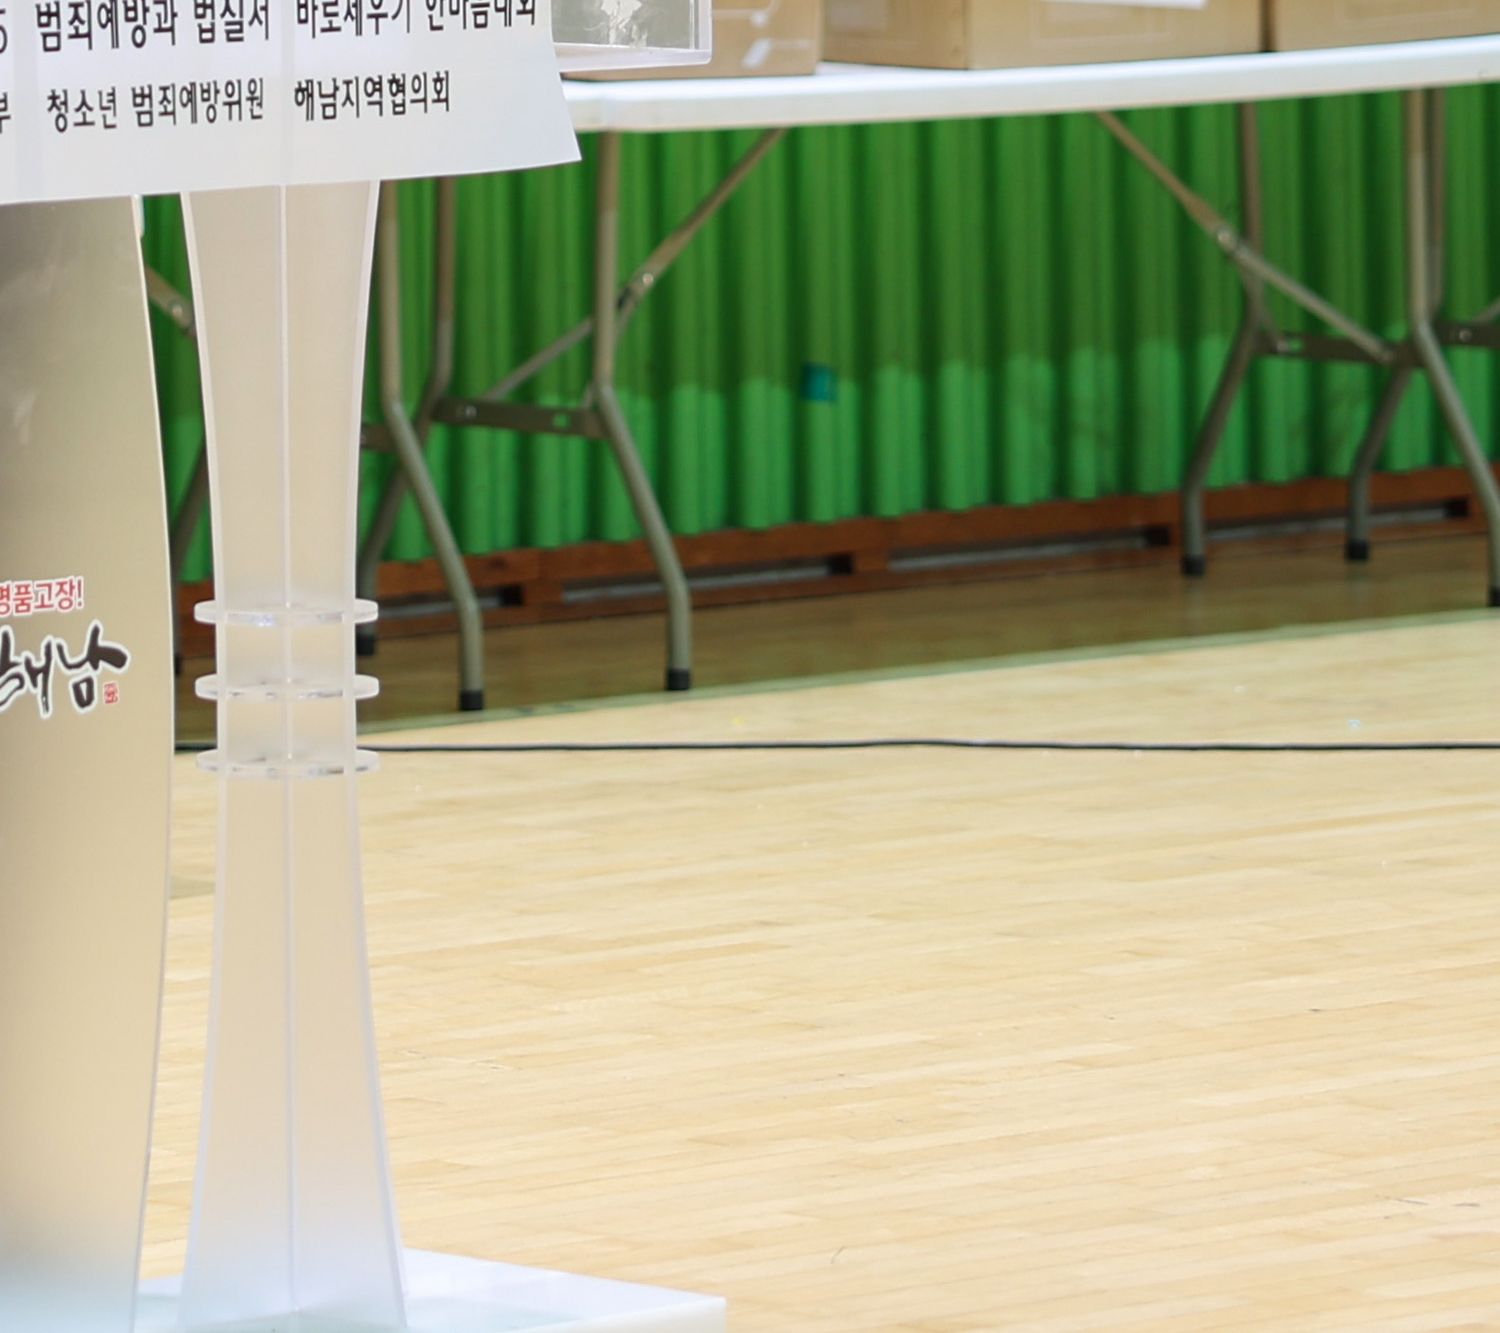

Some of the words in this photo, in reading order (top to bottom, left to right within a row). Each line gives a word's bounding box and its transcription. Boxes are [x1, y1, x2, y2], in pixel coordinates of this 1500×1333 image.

[47, 86, 119, 133] 청소년
[130, 76, 265, 128] 범죄예방위원
[293, 69, 451, 121] 해남지역협의회
